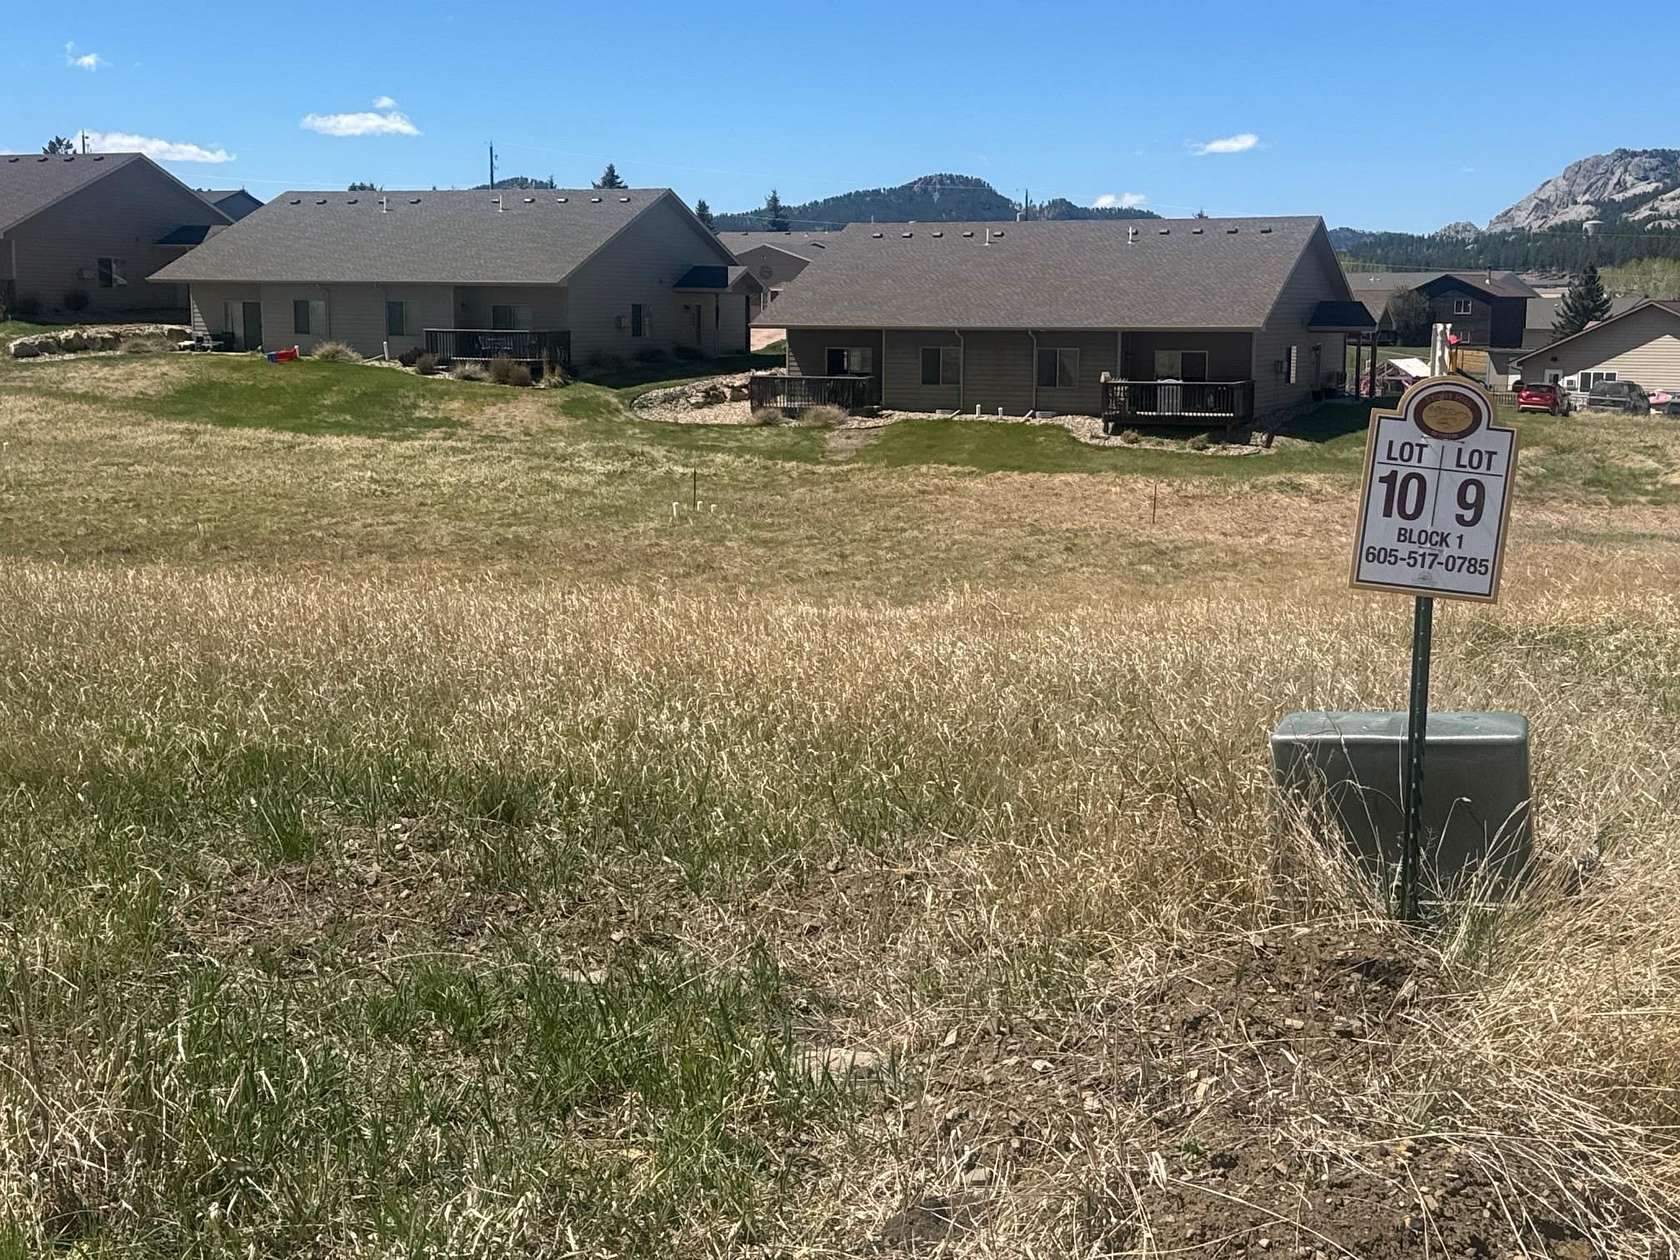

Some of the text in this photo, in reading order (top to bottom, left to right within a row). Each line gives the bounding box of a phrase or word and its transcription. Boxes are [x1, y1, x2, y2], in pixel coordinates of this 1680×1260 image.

[1386, 440, 1428, 464] LOT
[1455, 447, 1498, 471] LOT
[1378, 469, 1428, 521] 10
[1455, 478, 1486, 527] 9
[1396, 527, 1464, 549] BLOCK 1
[1365, 546, 1490, 576] 605-517-0785
